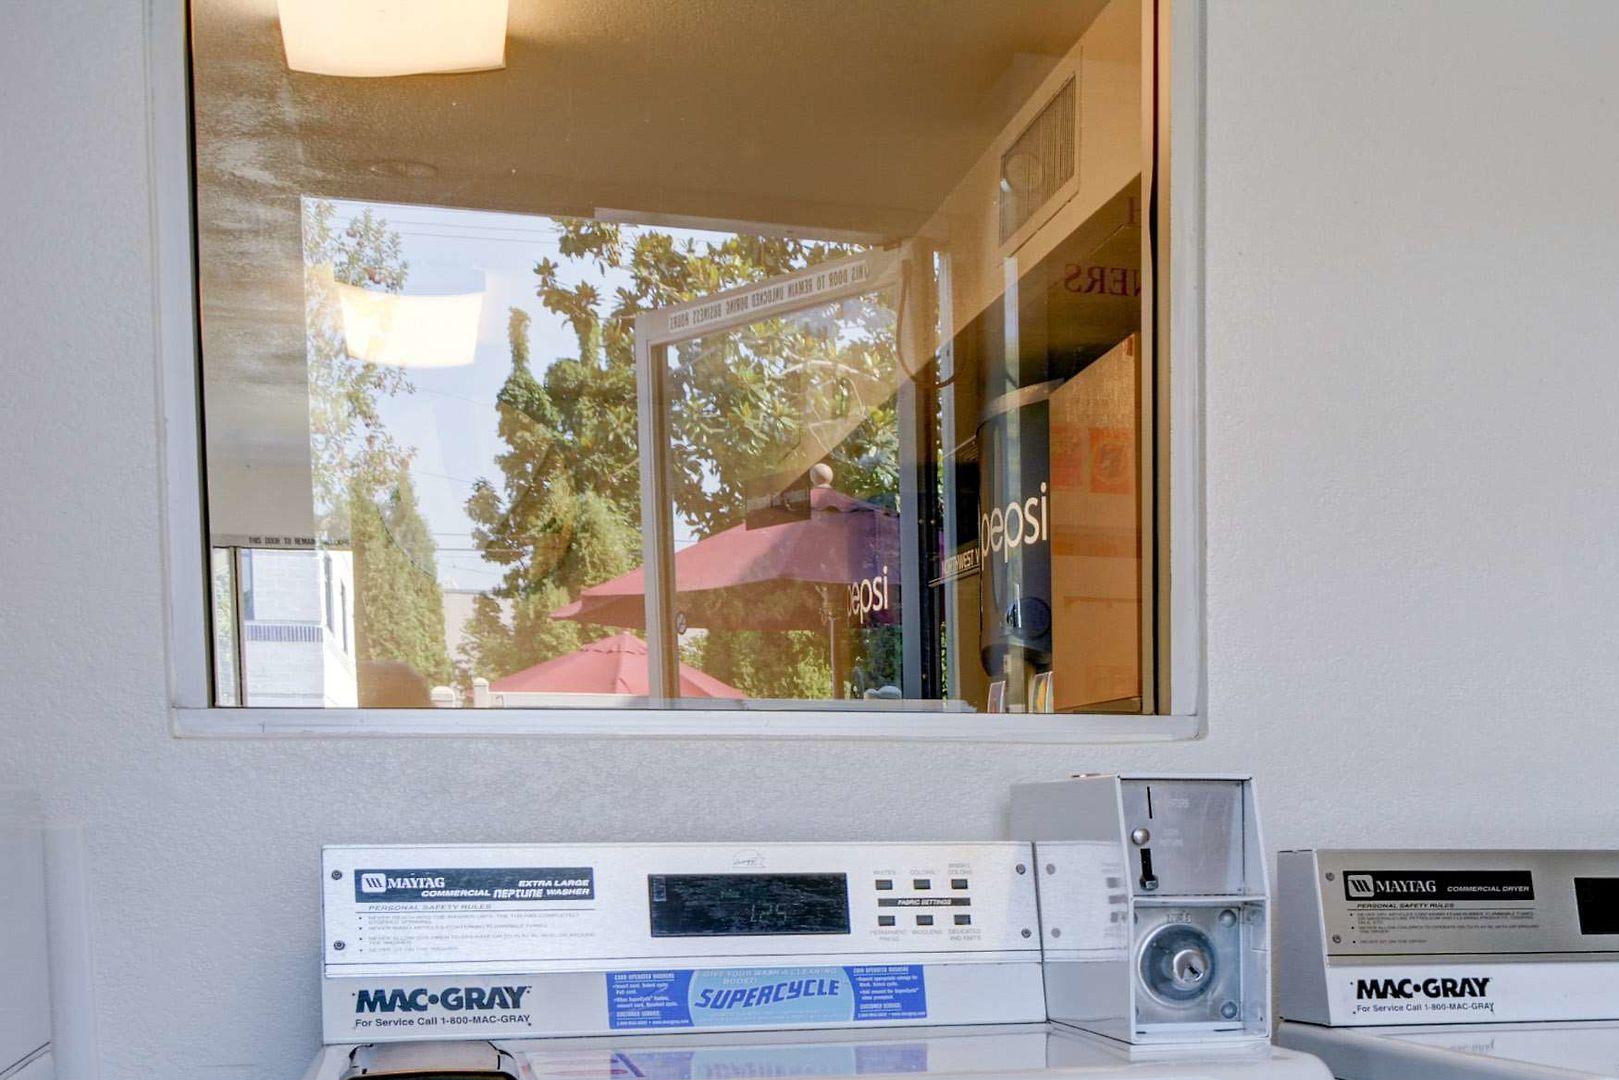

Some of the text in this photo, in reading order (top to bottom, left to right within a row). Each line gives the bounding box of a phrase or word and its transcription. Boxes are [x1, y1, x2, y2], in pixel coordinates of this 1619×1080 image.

[979, 482, 1048, 564] pepsi
[387, 877, 445, 889] MAYTAG
[518, 878, 589, 887] EXTRA LARGE
[1376, 880, 1437, 893] MAYTAG
[421, 889, 491, 898] COMMERCIAL
[546, 887, 590, 896] WASHER
[694, 979, 840, 1010] SUPERCYCLE
[1357, 1004, 1370, 1012] For
[1373, 1003, 1403, 1012] Service
[1405, 1003, 1422, 1011] Call
[355, 1018, 372, 1027] For
[375, 1017, 415, 1026] Service
[417, 1016, 438, 1025] Call
